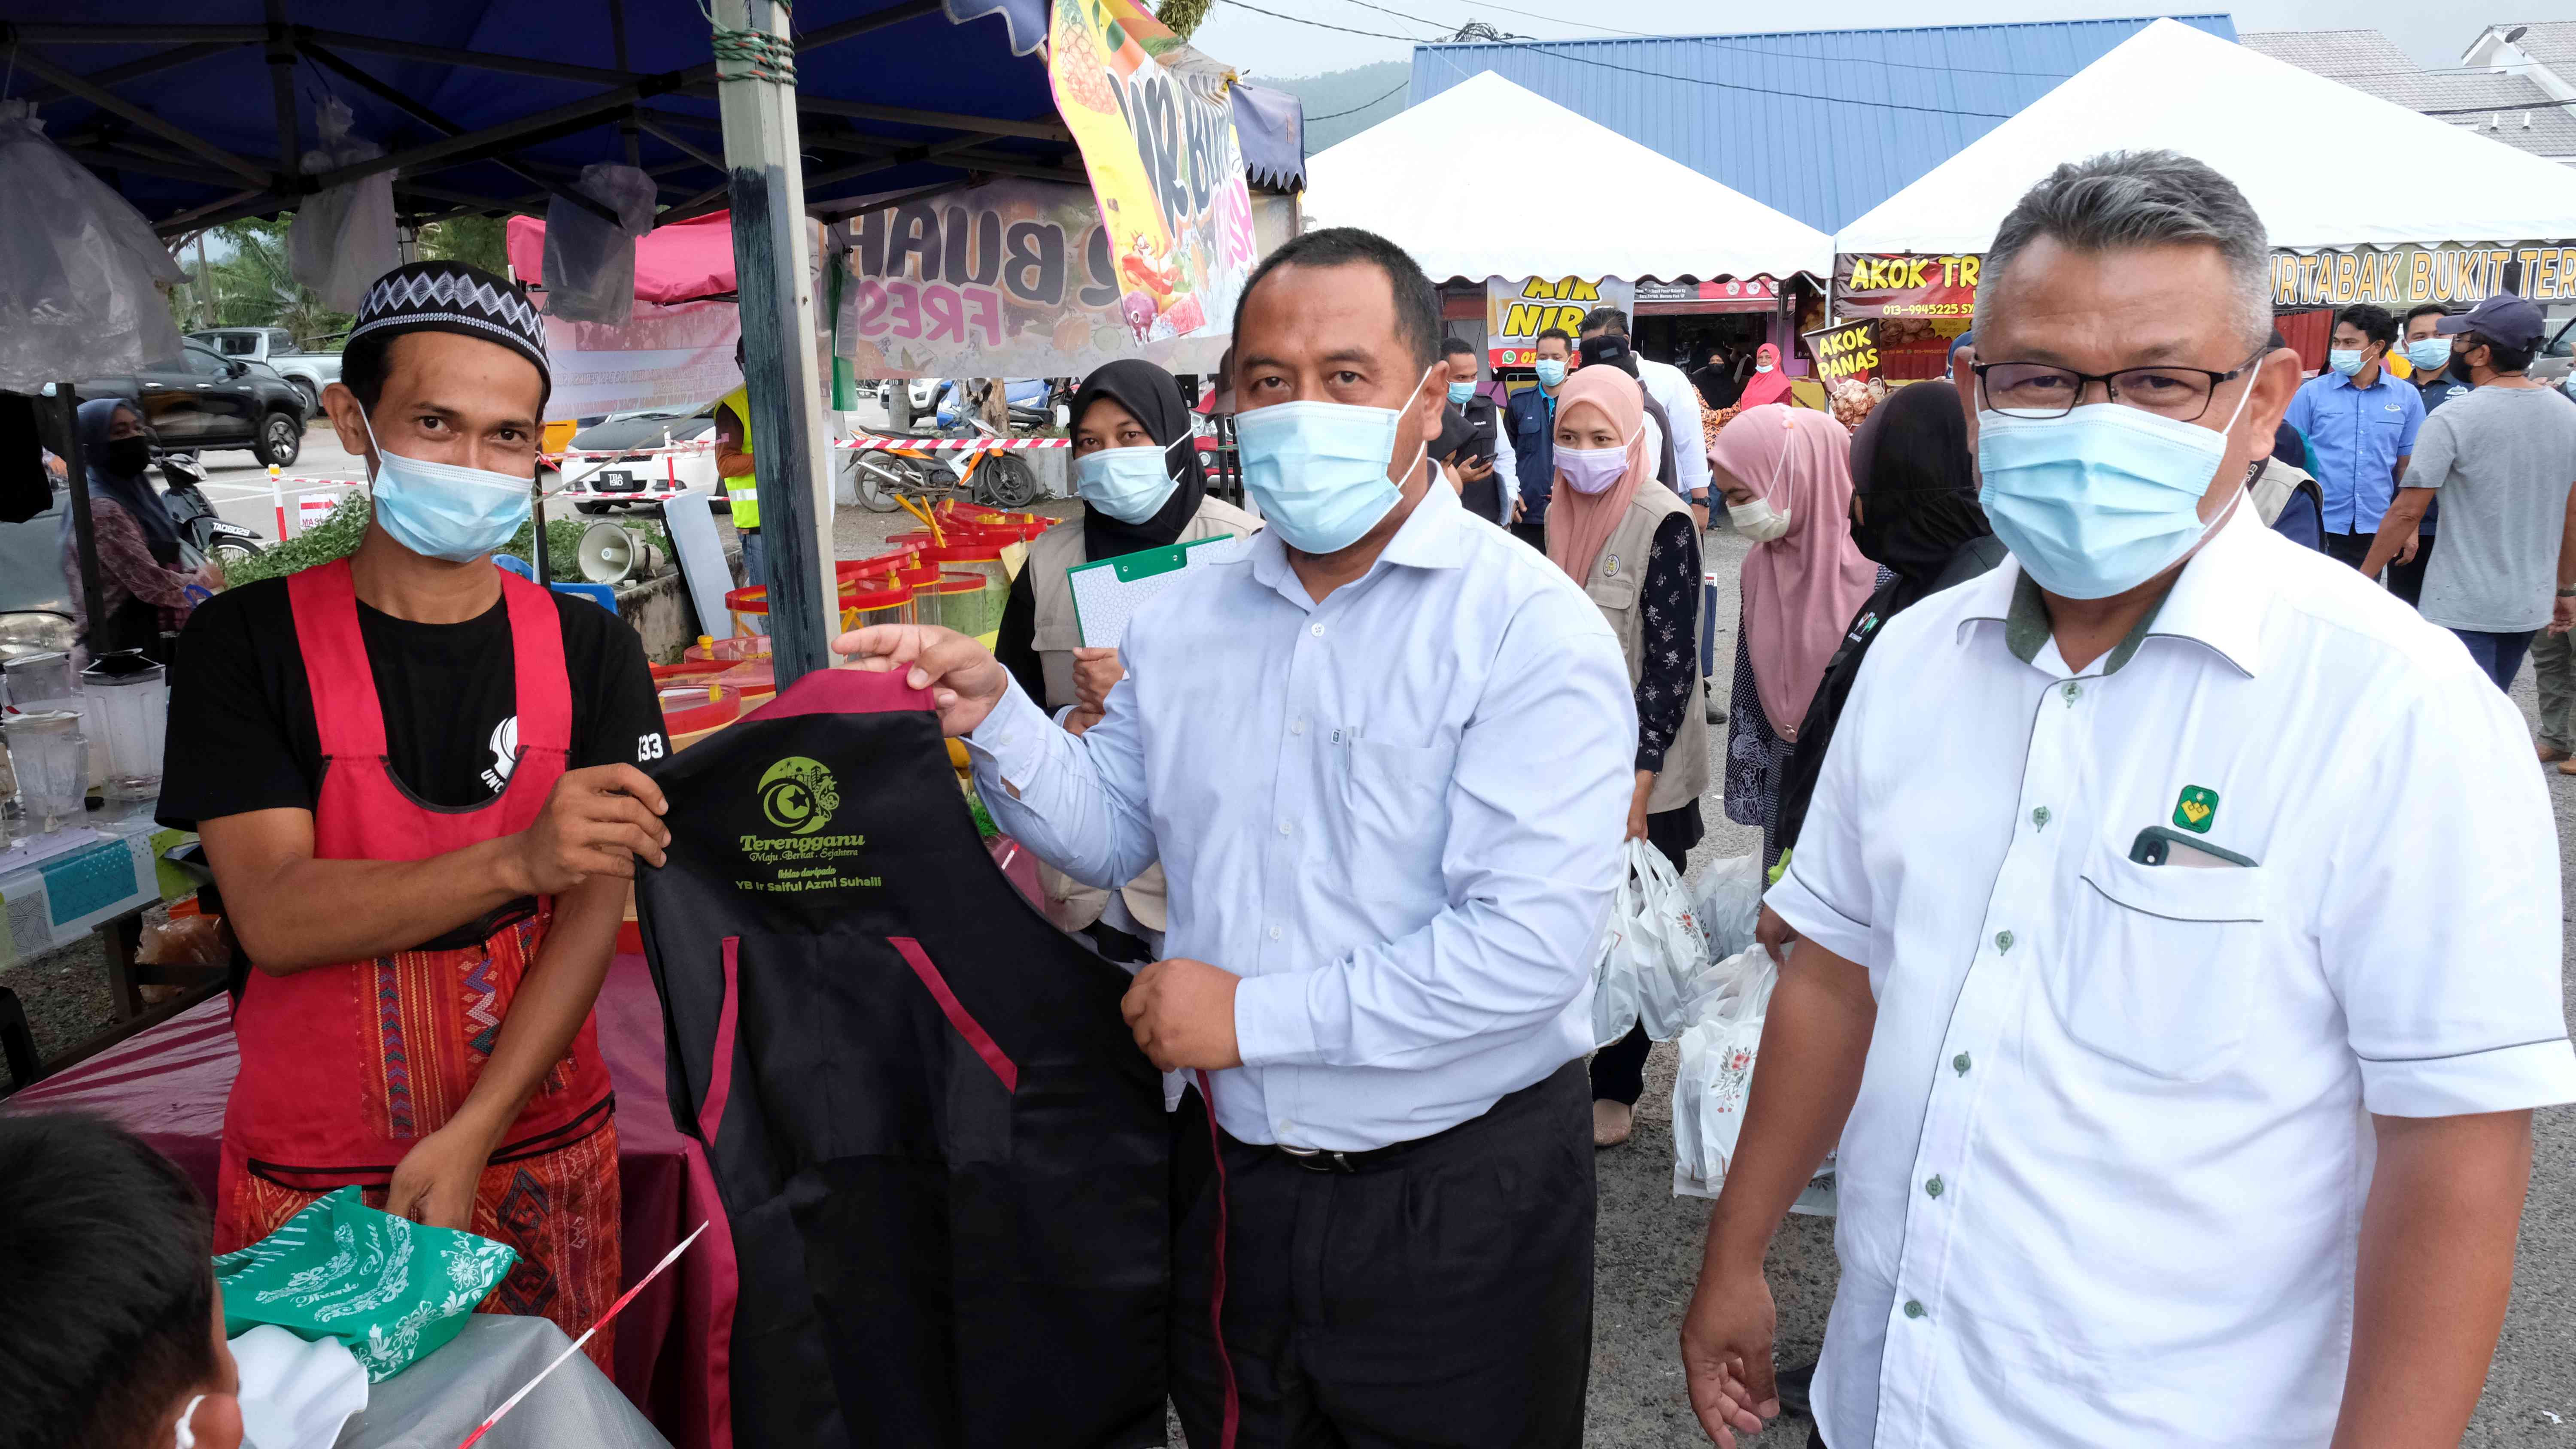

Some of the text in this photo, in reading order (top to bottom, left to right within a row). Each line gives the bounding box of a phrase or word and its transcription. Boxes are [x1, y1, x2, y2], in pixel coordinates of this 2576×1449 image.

[1850, 255, 1980, 290] AKOK TR
[2270, 253, 2403, 304] RTABAK
[2408, 251, 2512, 303] BUKIT
[1522, 276, 1604, 302] AIR
[1503, 303, 1586, 338] NIR
[1883, 303, 1975, 315] 013-9945225 SY
[1819, 325, 1872, 358] AKOK
[1817, 348, 1879, 382] PANAS
[480, 768, 505, 793] UNC
[740, 834, 866, 852] Terengganu
[735, 876, 882, 892] YB Ir Saiful Azmi Suhaili
